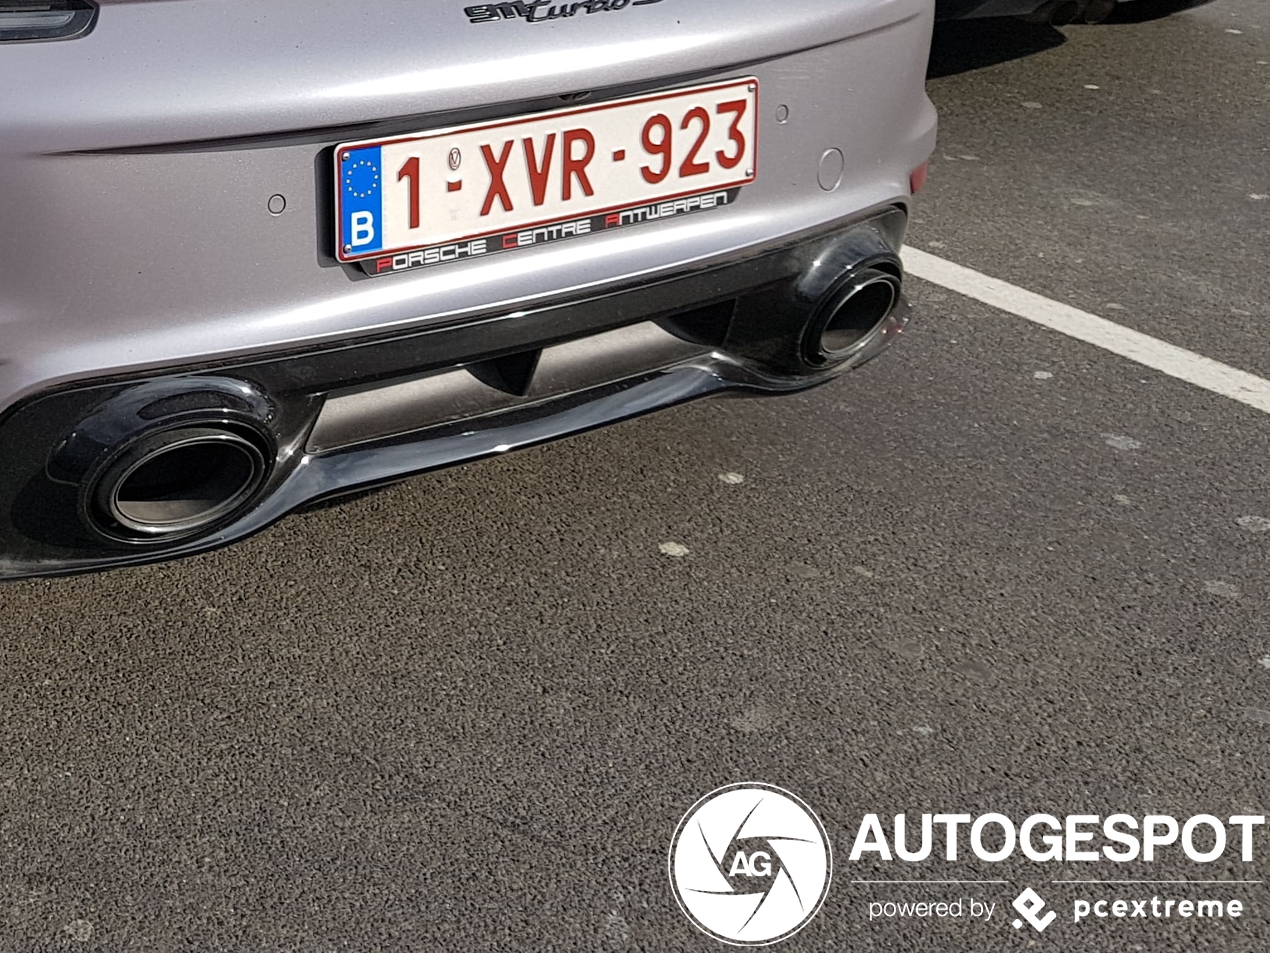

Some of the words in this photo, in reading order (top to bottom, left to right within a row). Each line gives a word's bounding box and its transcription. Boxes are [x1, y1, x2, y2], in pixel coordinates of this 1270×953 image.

[397, 99, 748, 230] 1-XVR-923
[350, 210, 375, 247] B
[376, 239, 487, 273] PORSCHE
[502, 219, 592, 249] CENTRE
[604, 191, 728, 228] ANTWERPEN
